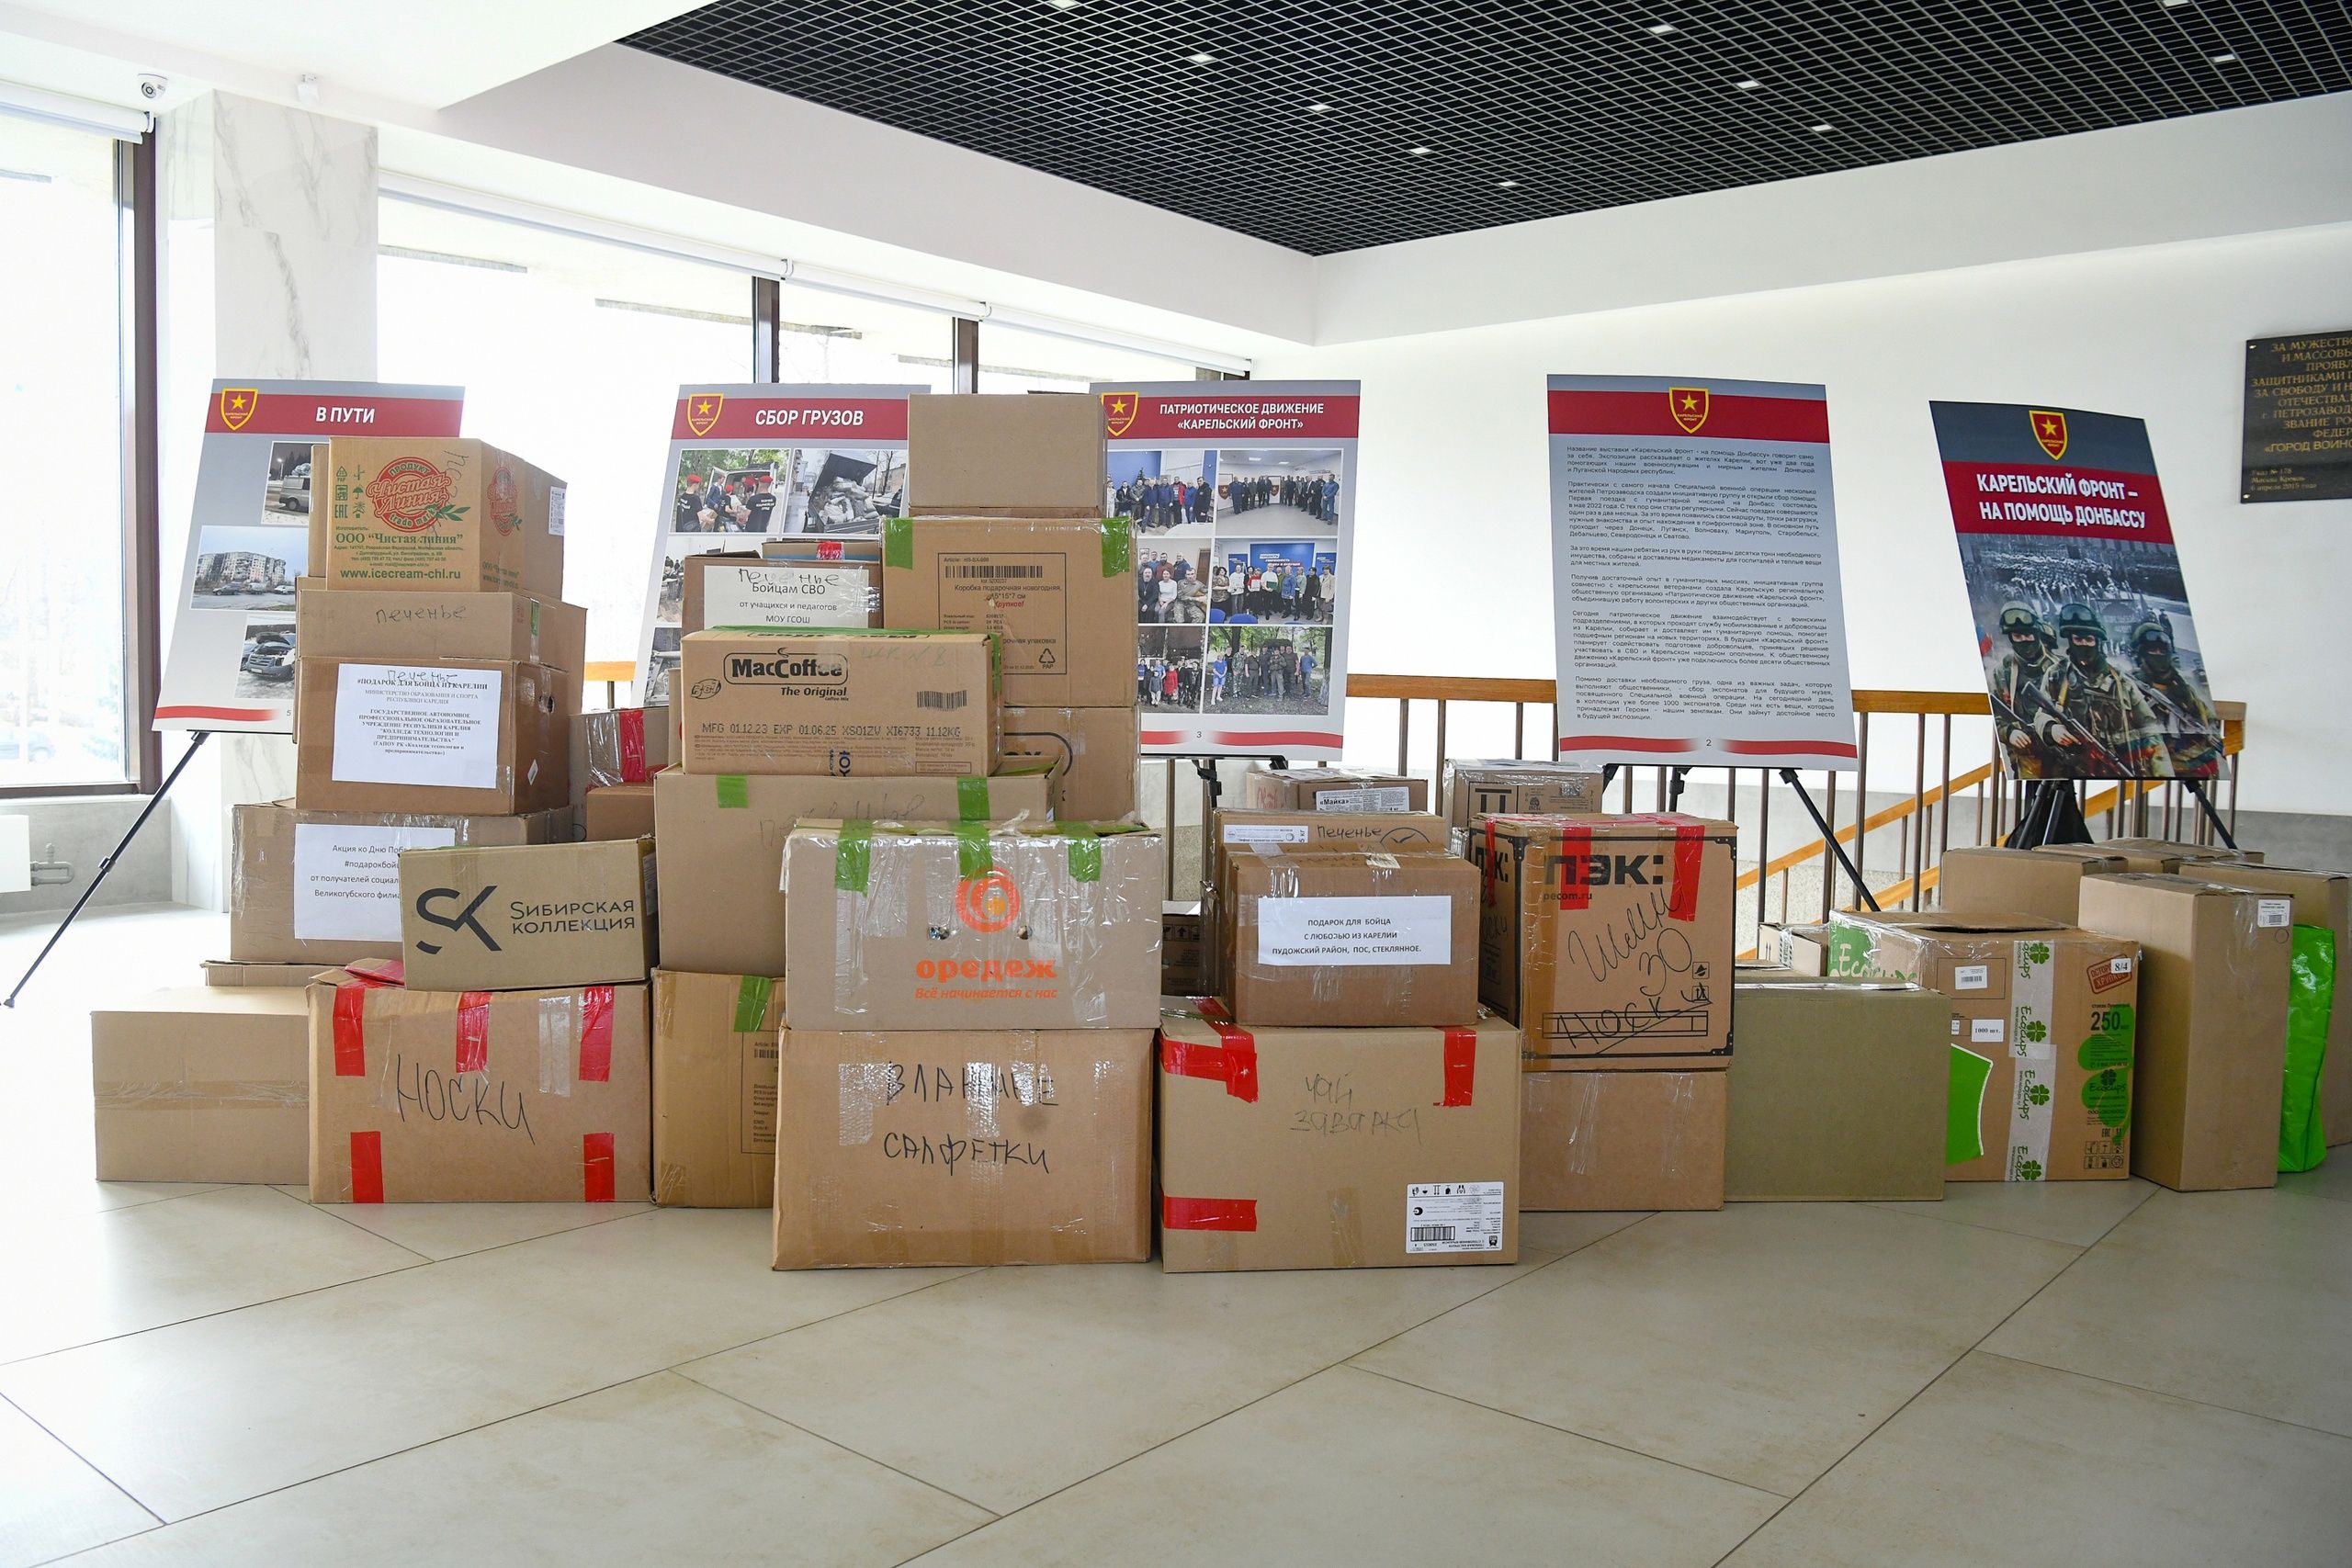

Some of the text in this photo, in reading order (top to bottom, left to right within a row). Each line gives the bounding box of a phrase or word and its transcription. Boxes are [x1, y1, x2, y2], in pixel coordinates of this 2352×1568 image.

[2271, 343, 2286, 352] ЗА
[2255, 389, 2268, 398] ЗА
[2272, 384, 2328, 396] СВОБОДУ
[316, 407, 376, 423] В ПУТИ
[1159, 403, 1324, 415] ПАТРИОТИЧЕСКОЕ ДВИЖЕНИЕ
[2274, 405, 2352, 418] ПЕТРОЗАВОД
[755, 410, 864, 426] СБОР ГРУЗОВ
[1177, 416, 1304, 430] «КАРЕЛЬСКИЙ ФРОНТ»
[2283, 418, 2330, 429] ЗВАНИЕ
[390, 463, 431, 476] ПРОДУКТ
[368, 475, 451, 497] Чистая
[1976, 472, 2125, 500] КАРЕЛЬСКИЙ ФРОНТ
[376, 490, 449, 516] Линия
[390, 514, 413, 527] trade
[1979, 502, 2145, 529] НА ПОМОЩЬ ДОНБАССУ
[336, 533, 365, 544] ООО
[340, 568, 461, 579] www.icecream-chl.ru
[752, 582, 826, 595] Бойцам СВО
[751, 602, 788, 610] учащихся
[786, 615, 810, 624] ГСОШ
[731, 659, 842, 679] MacCoffee
[781, 687, 847, 698] The Original
[702, 723, 724, 734] MFG
[730, 723, 768, 734] 01.12.23
[774, 724, 793, 735] EXP
[799, 725, 837, 735] 01.06.25
[1196, 730, 1203, 739] 3
[1705, 739, 1713, 747] 2
[1317, 824, 1382, 840] Печенье
[368, 845, 386, 853] Дню
[321, 875, 369, 885] получателей
[315, 889, 375, 898] Великогубского
[1543, 891, 1592, 902] pecom.ru
[513, 917, 635, 934] КОЛЛЕКЦИЯ
[1308, 919, 1344, 927] ПОДАРОК
[1365, 917, 1391, 926] БОЙЦА
[1363, 931, 1397, 940] КАРЕЛИИ
[1272, 945, 1320, 955] ПУДОЖСКИЙ
[1322, 945, 1351, 954] РАЙОН,
[916, 959, 1058, 984] оредеж
[2115, 963, 2128, 971] 8/4
[914, 987, 1058, 999] Всё начинается с нас
[2090, 1011, 2120, 1031] 250
[2015, 1006, 2032, 1057] Ecocups
[2018, 1069, 2035, 1120] Ecocups
